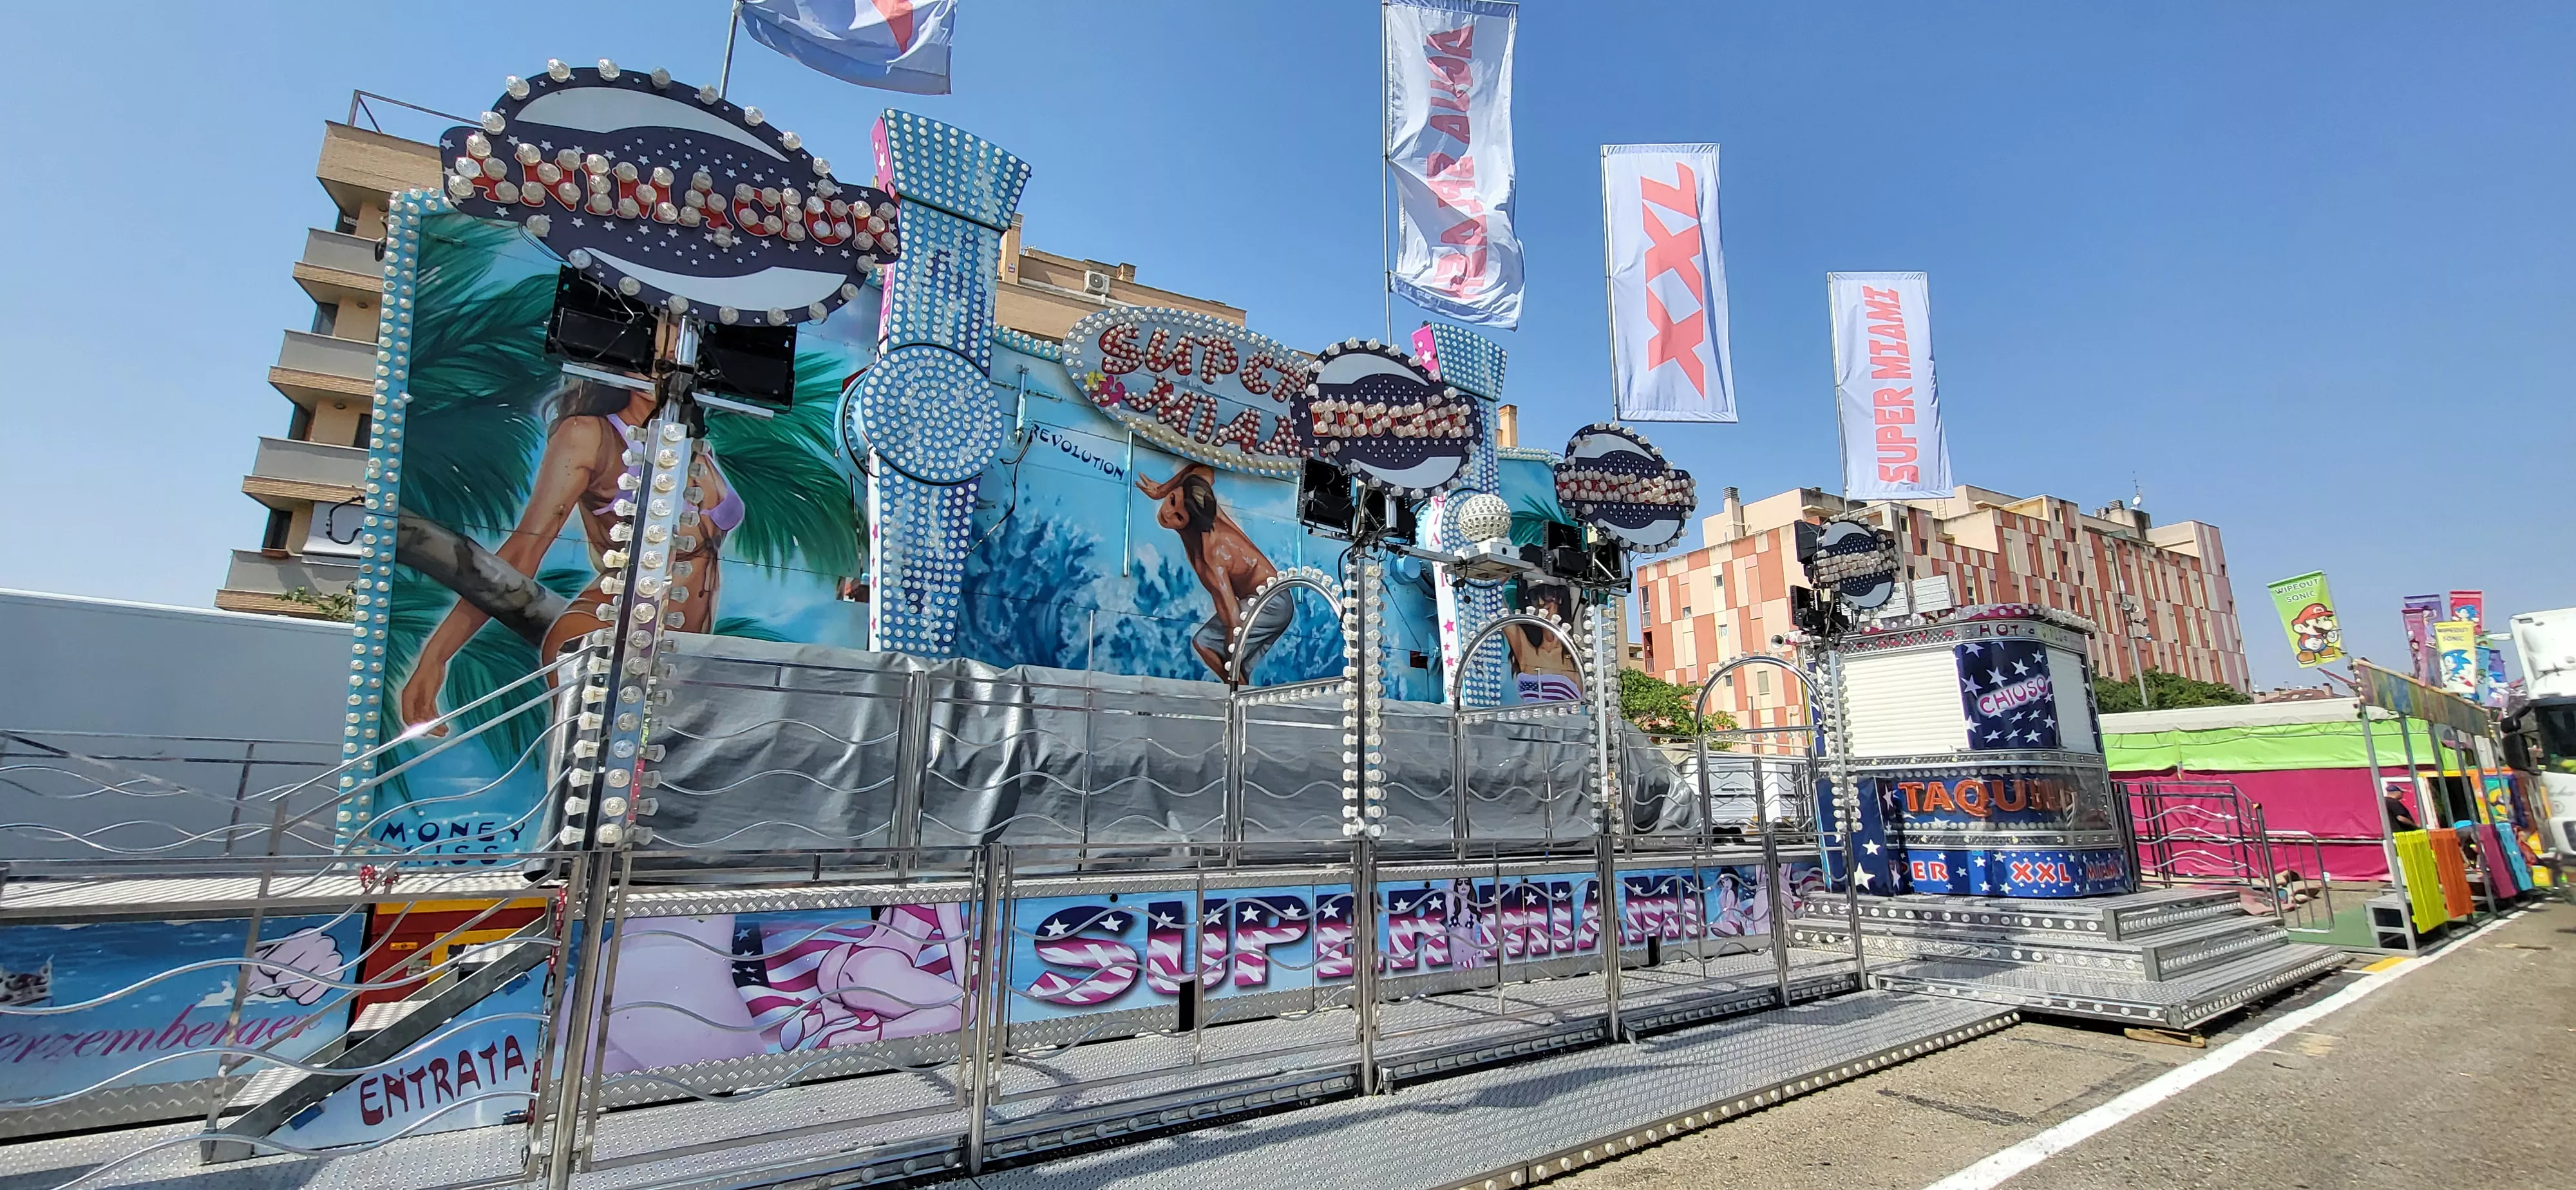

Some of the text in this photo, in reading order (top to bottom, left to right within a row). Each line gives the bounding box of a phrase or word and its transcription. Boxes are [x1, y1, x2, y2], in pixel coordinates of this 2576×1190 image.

[1639, 161, 1705, 401] XXL
[1098, 322, 1309, 404] SUPER
[1862, 285, 1920, 484] SUPER MIAMI
[1030, 423, 1125, 481] REVOLUTION
[1430, 493, 1446, 587] MIAI
[2275, 578, 2318, 594] WIPEOUT
[2286, 590, 2316, 603] SONIC
[1979, 623, 2019, 636] HOT
[1979, 676, 2047, 713] CHIUSO
[379, 822, 526, 843] MONEY
[2010, 862, 2072, 883] XXL
[1026, 876, 1707, 1005] SUPER MIAMI
[360, 1035, 527, 1126] ENTRATA
